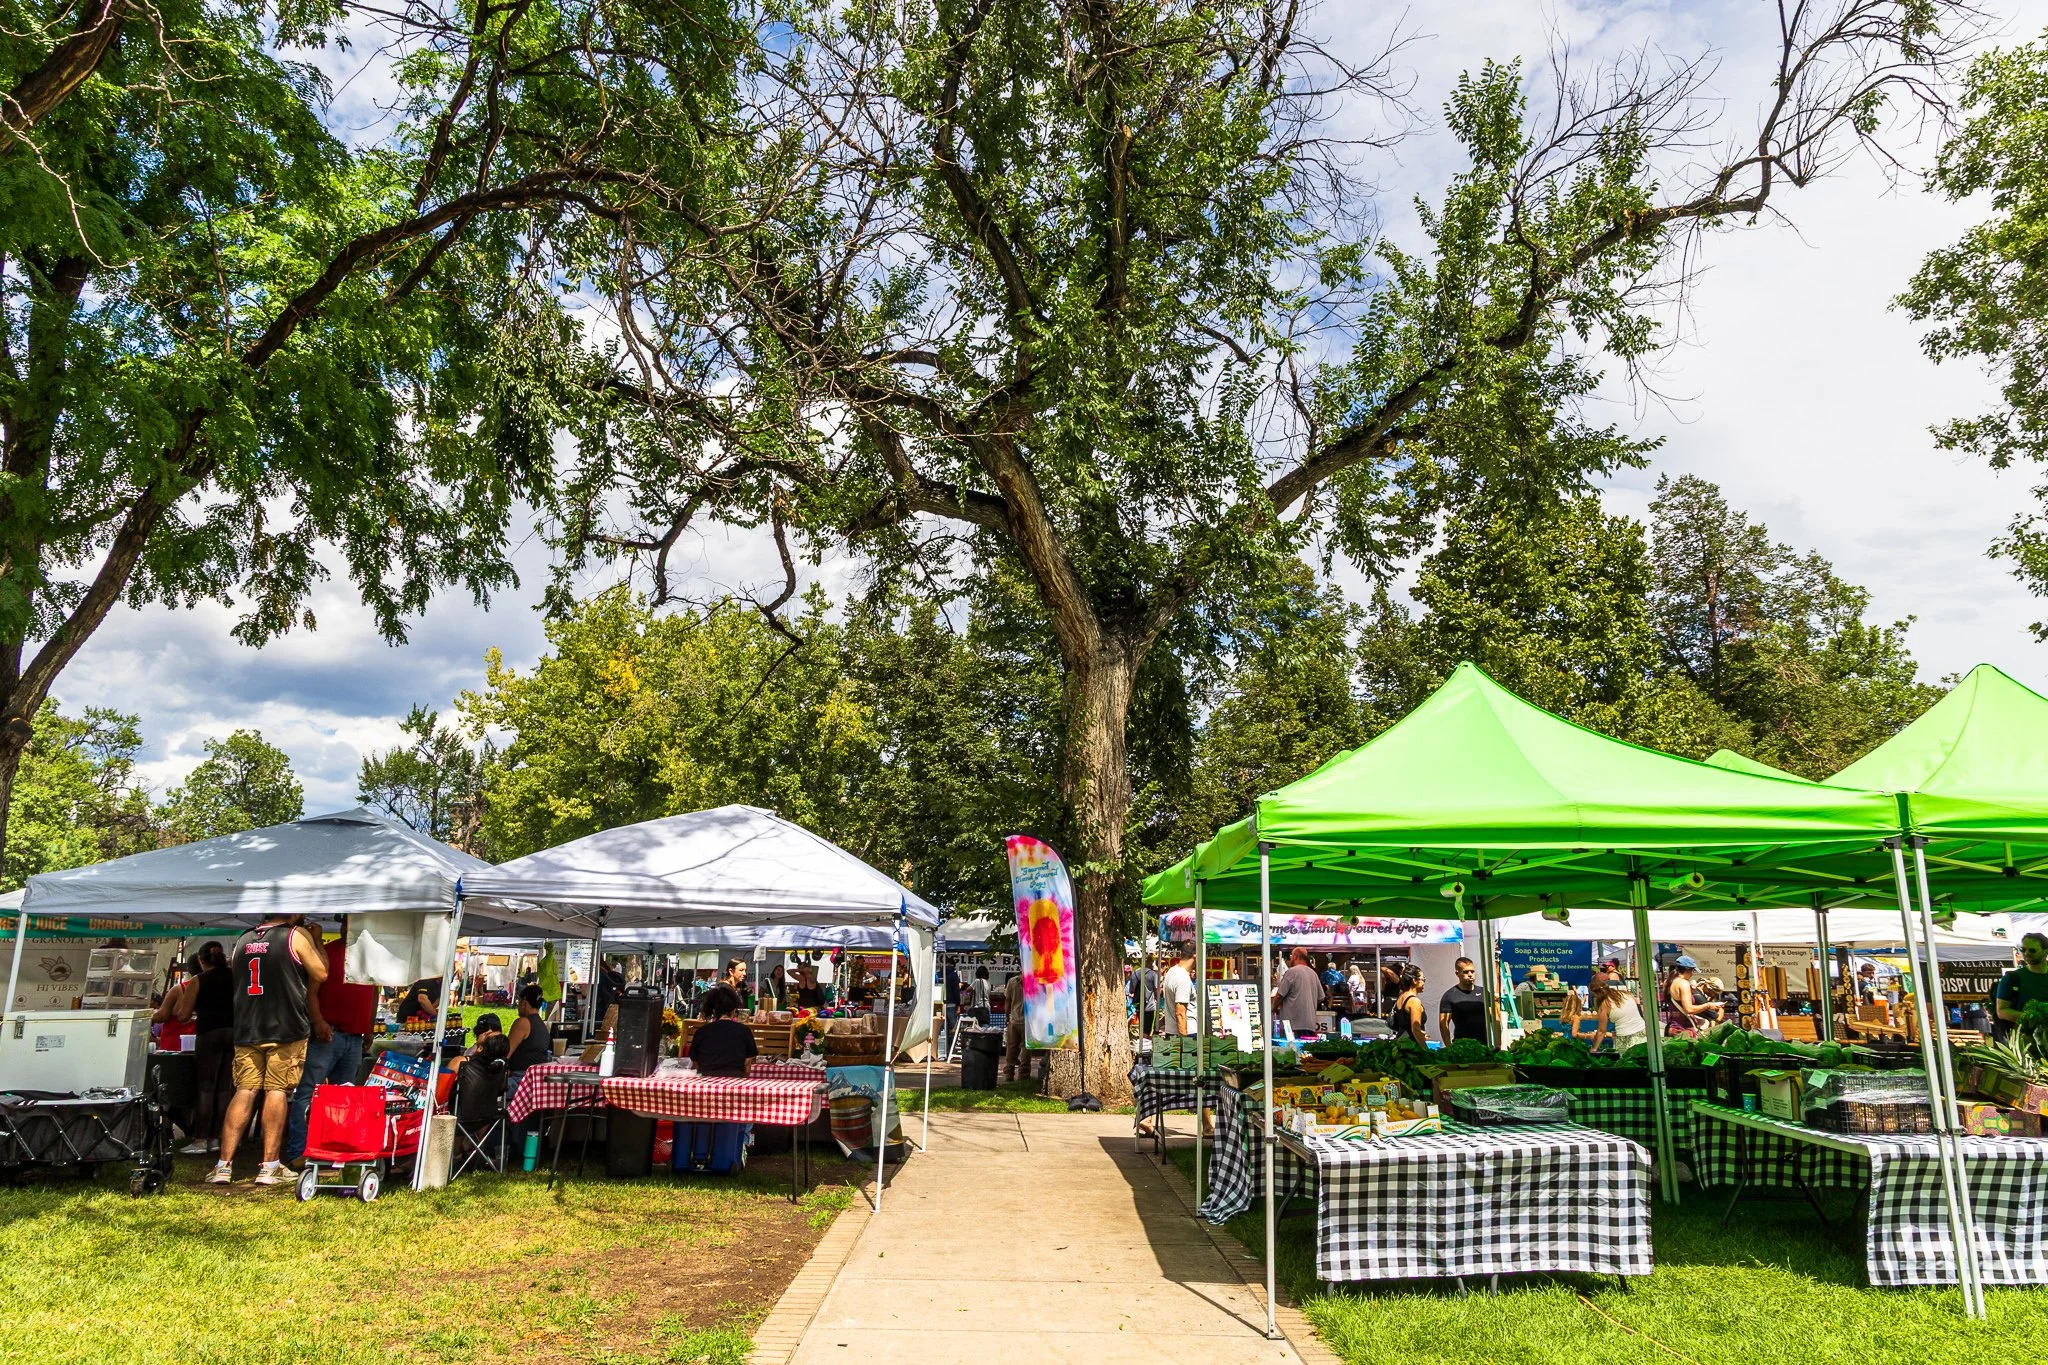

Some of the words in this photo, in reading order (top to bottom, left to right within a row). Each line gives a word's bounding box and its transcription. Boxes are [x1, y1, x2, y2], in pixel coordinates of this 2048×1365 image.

[34, 915, 69, 931] JUICE
[1396, 919, 1429, 938] Pops
[245, 942, 270, 954] ROSE
[1514, 947, 1532, 955] Soap
[247, 957, 264, 995] 1
[36, 984, 49, 992] HI
[52, 984, 79, 992] VIBES
[1940, 977, 1971, 993] RISPY
[1385, 1122, 1408, 1132] MANGO
